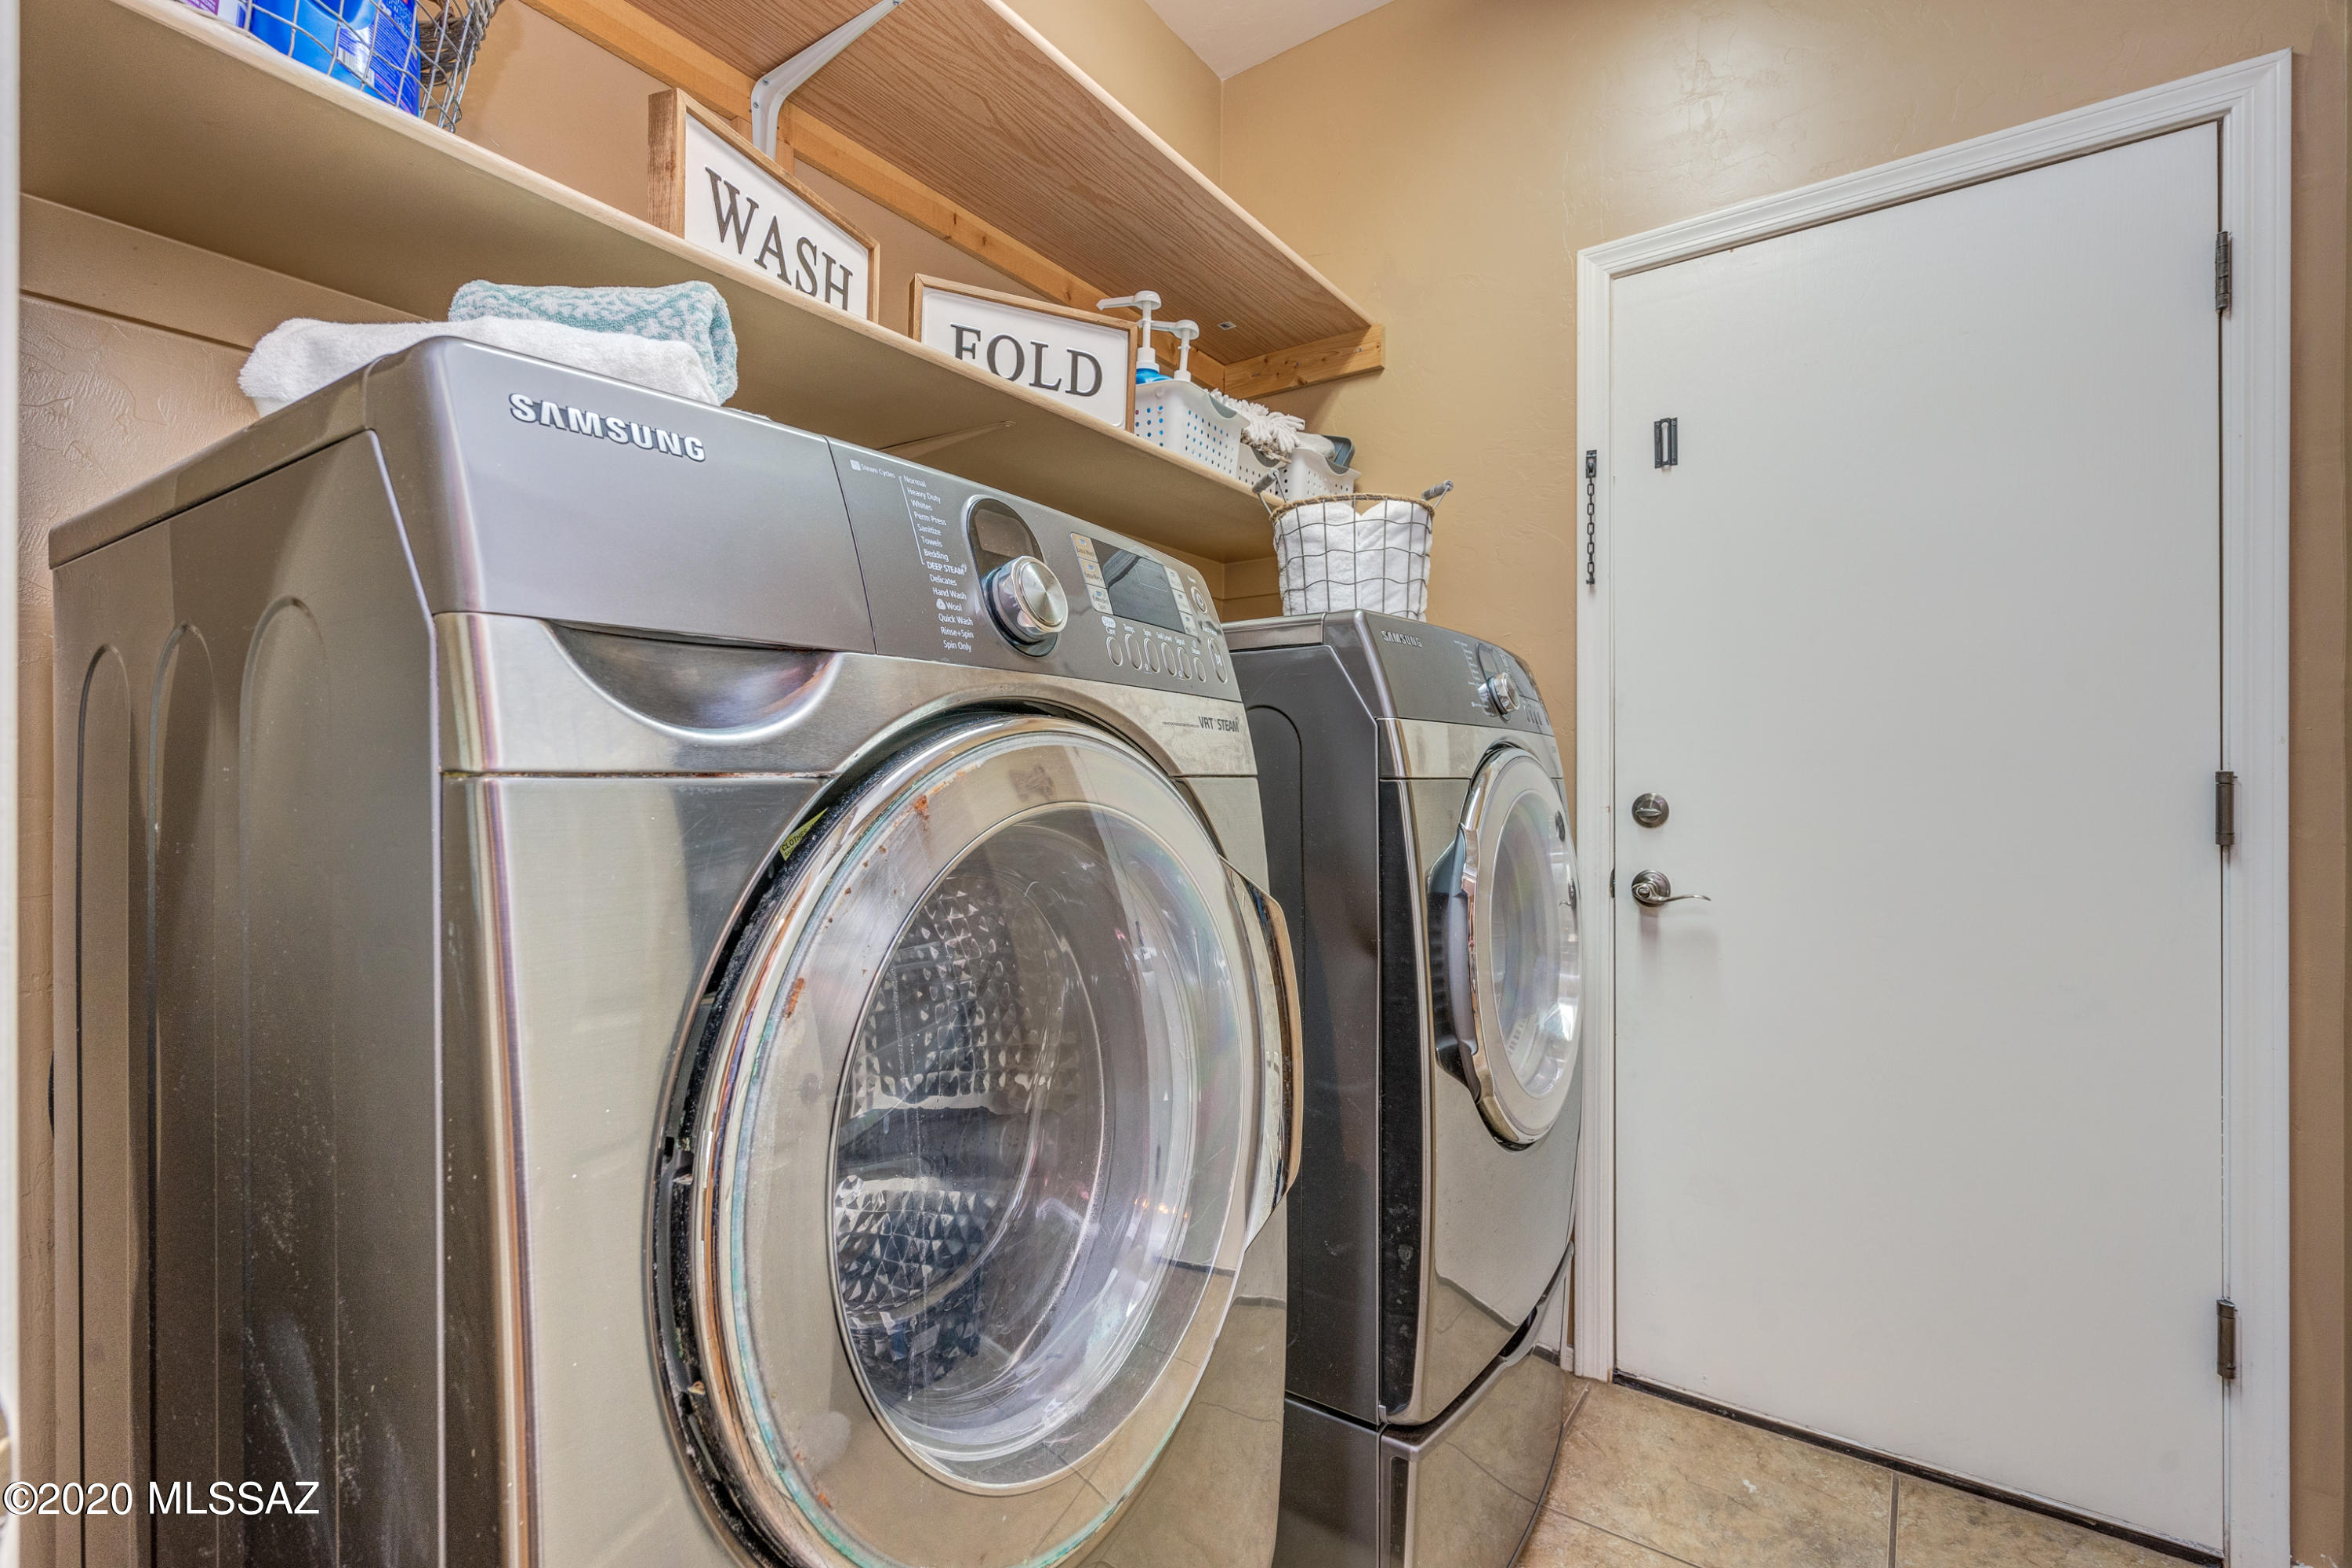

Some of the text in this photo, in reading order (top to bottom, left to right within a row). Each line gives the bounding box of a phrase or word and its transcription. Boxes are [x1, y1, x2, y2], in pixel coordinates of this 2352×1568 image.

[704, 165, 853, 311] WASH
[950, 322, 1103, 397] FOLD
[509, 393, 706, 463] SAMSUNG
[903, 474, 927, 488] Normal
[906, 487, 941, 504] Heavy Duty
[910, 499, 933, 511] Whites
[913, 510, 947, 526] Perm Press
[916, 523, 942, 536] Sanitize
[920, 535, 943, 548] Towels
[923, 548, 949, 563] Bedding
[926, 561, 966, 576] DEEP STEAM
[929, 573, 957, 586] Delicates
[932, 586, 967, 601] Hand Wash
[946, 601, 963, 612] Wool
[938, 613, 974, 626] Quick Wash
[940, 626, 975, 640] Rinse+Spin
[1381, 630, 1423, 648] SAMSUNG
[942, 639, 972, 653] Spin Only
[1198, 715, 1214, 730] VRT
[1217, 718, 1240, 733] STEAM
